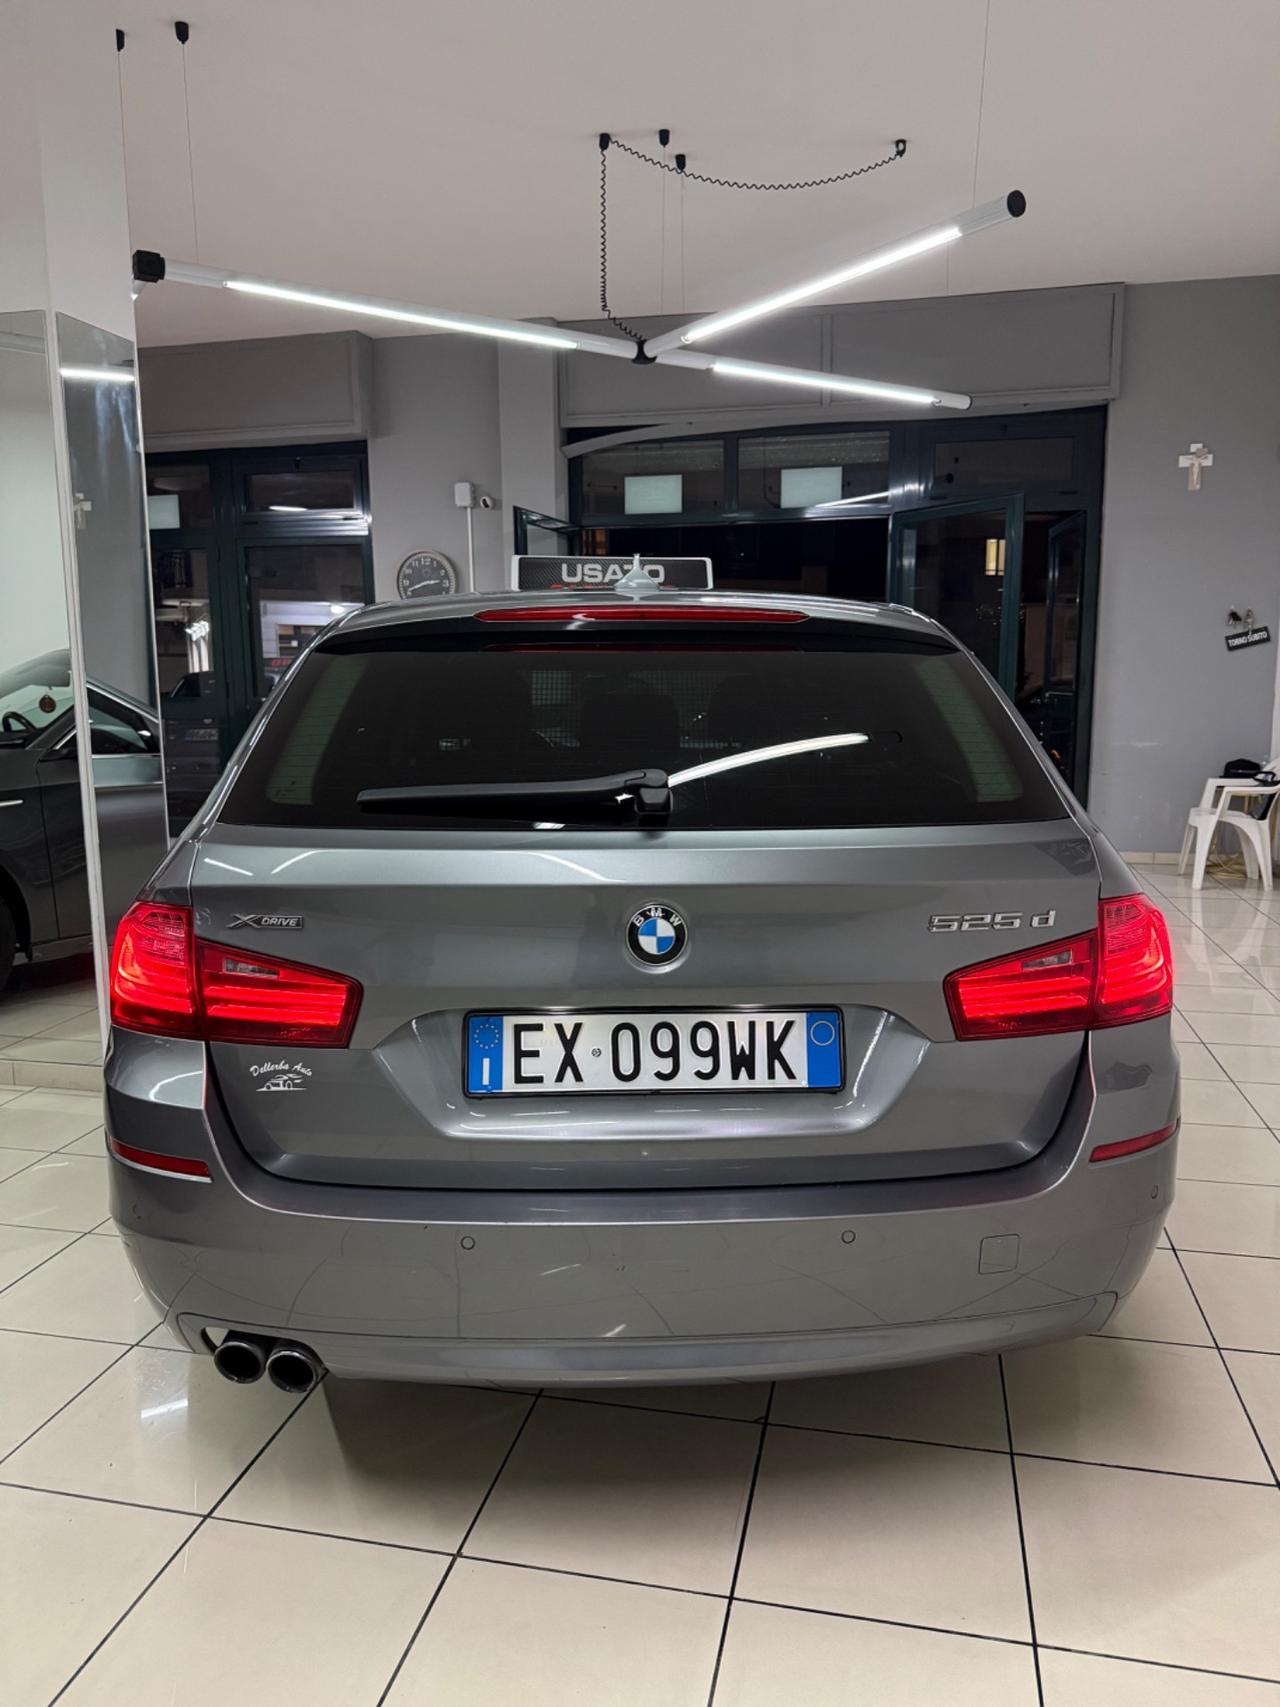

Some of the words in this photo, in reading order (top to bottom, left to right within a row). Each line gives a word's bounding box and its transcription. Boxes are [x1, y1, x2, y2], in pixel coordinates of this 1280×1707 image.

[561, 563, 665, 583] USAO
[632, 907, 682, 927] BMW
[929, 912, 1022, 932] 525
[1031, 910, 1056, 928] d
[513, 1023, 584, 1084] EX
[610, 1020, 797, 1083] 099WK
